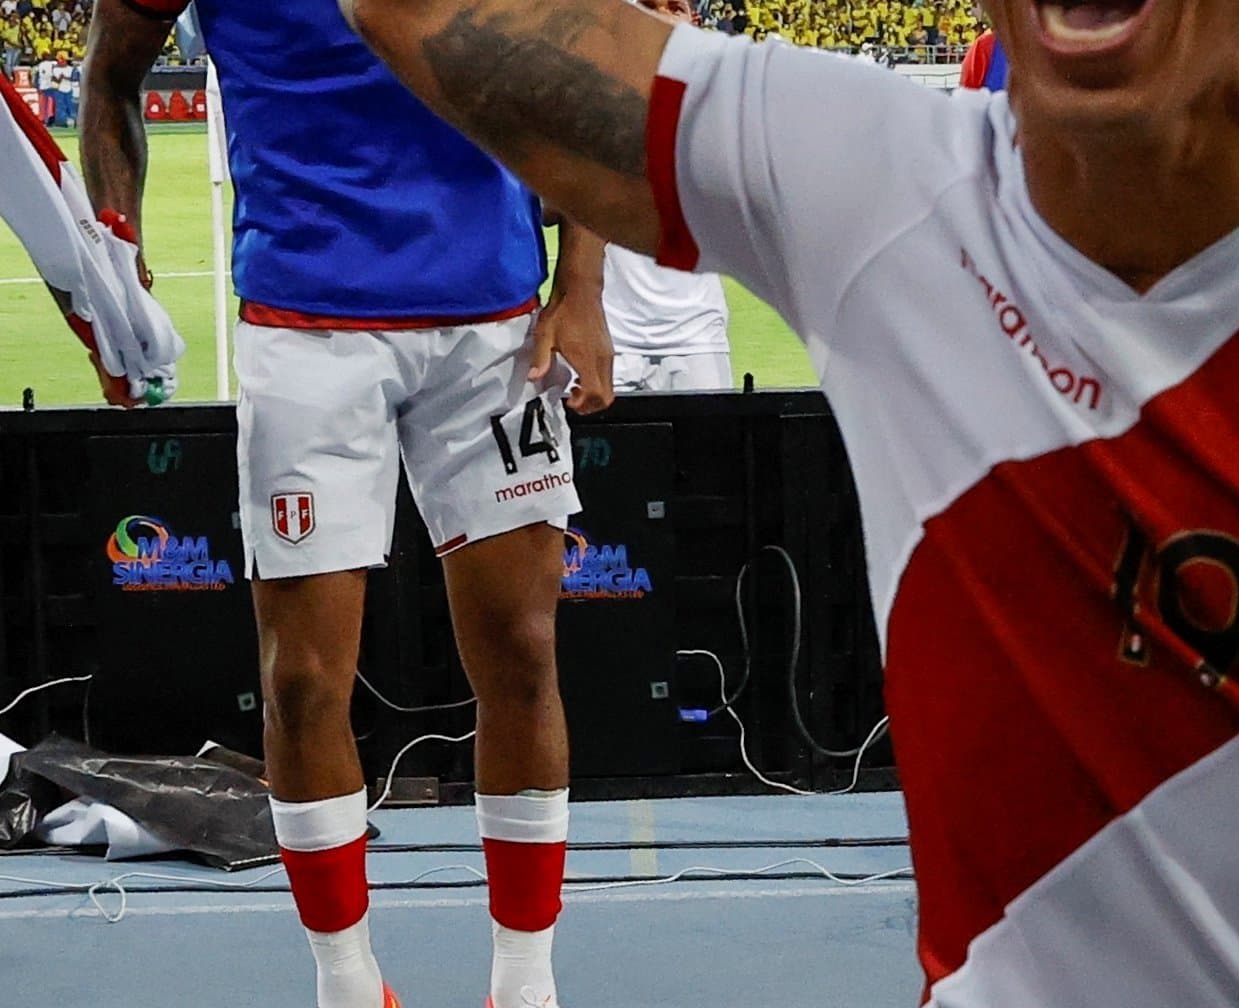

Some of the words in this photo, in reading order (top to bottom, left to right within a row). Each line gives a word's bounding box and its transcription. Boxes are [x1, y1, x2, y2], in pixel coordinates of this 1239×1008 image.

[490, 396, 561, 476] 14
[495, 471, 571, 503] maratho
[137, 536, 210, 560] M&M
[112, 559, 235, 585] SINERGIA
